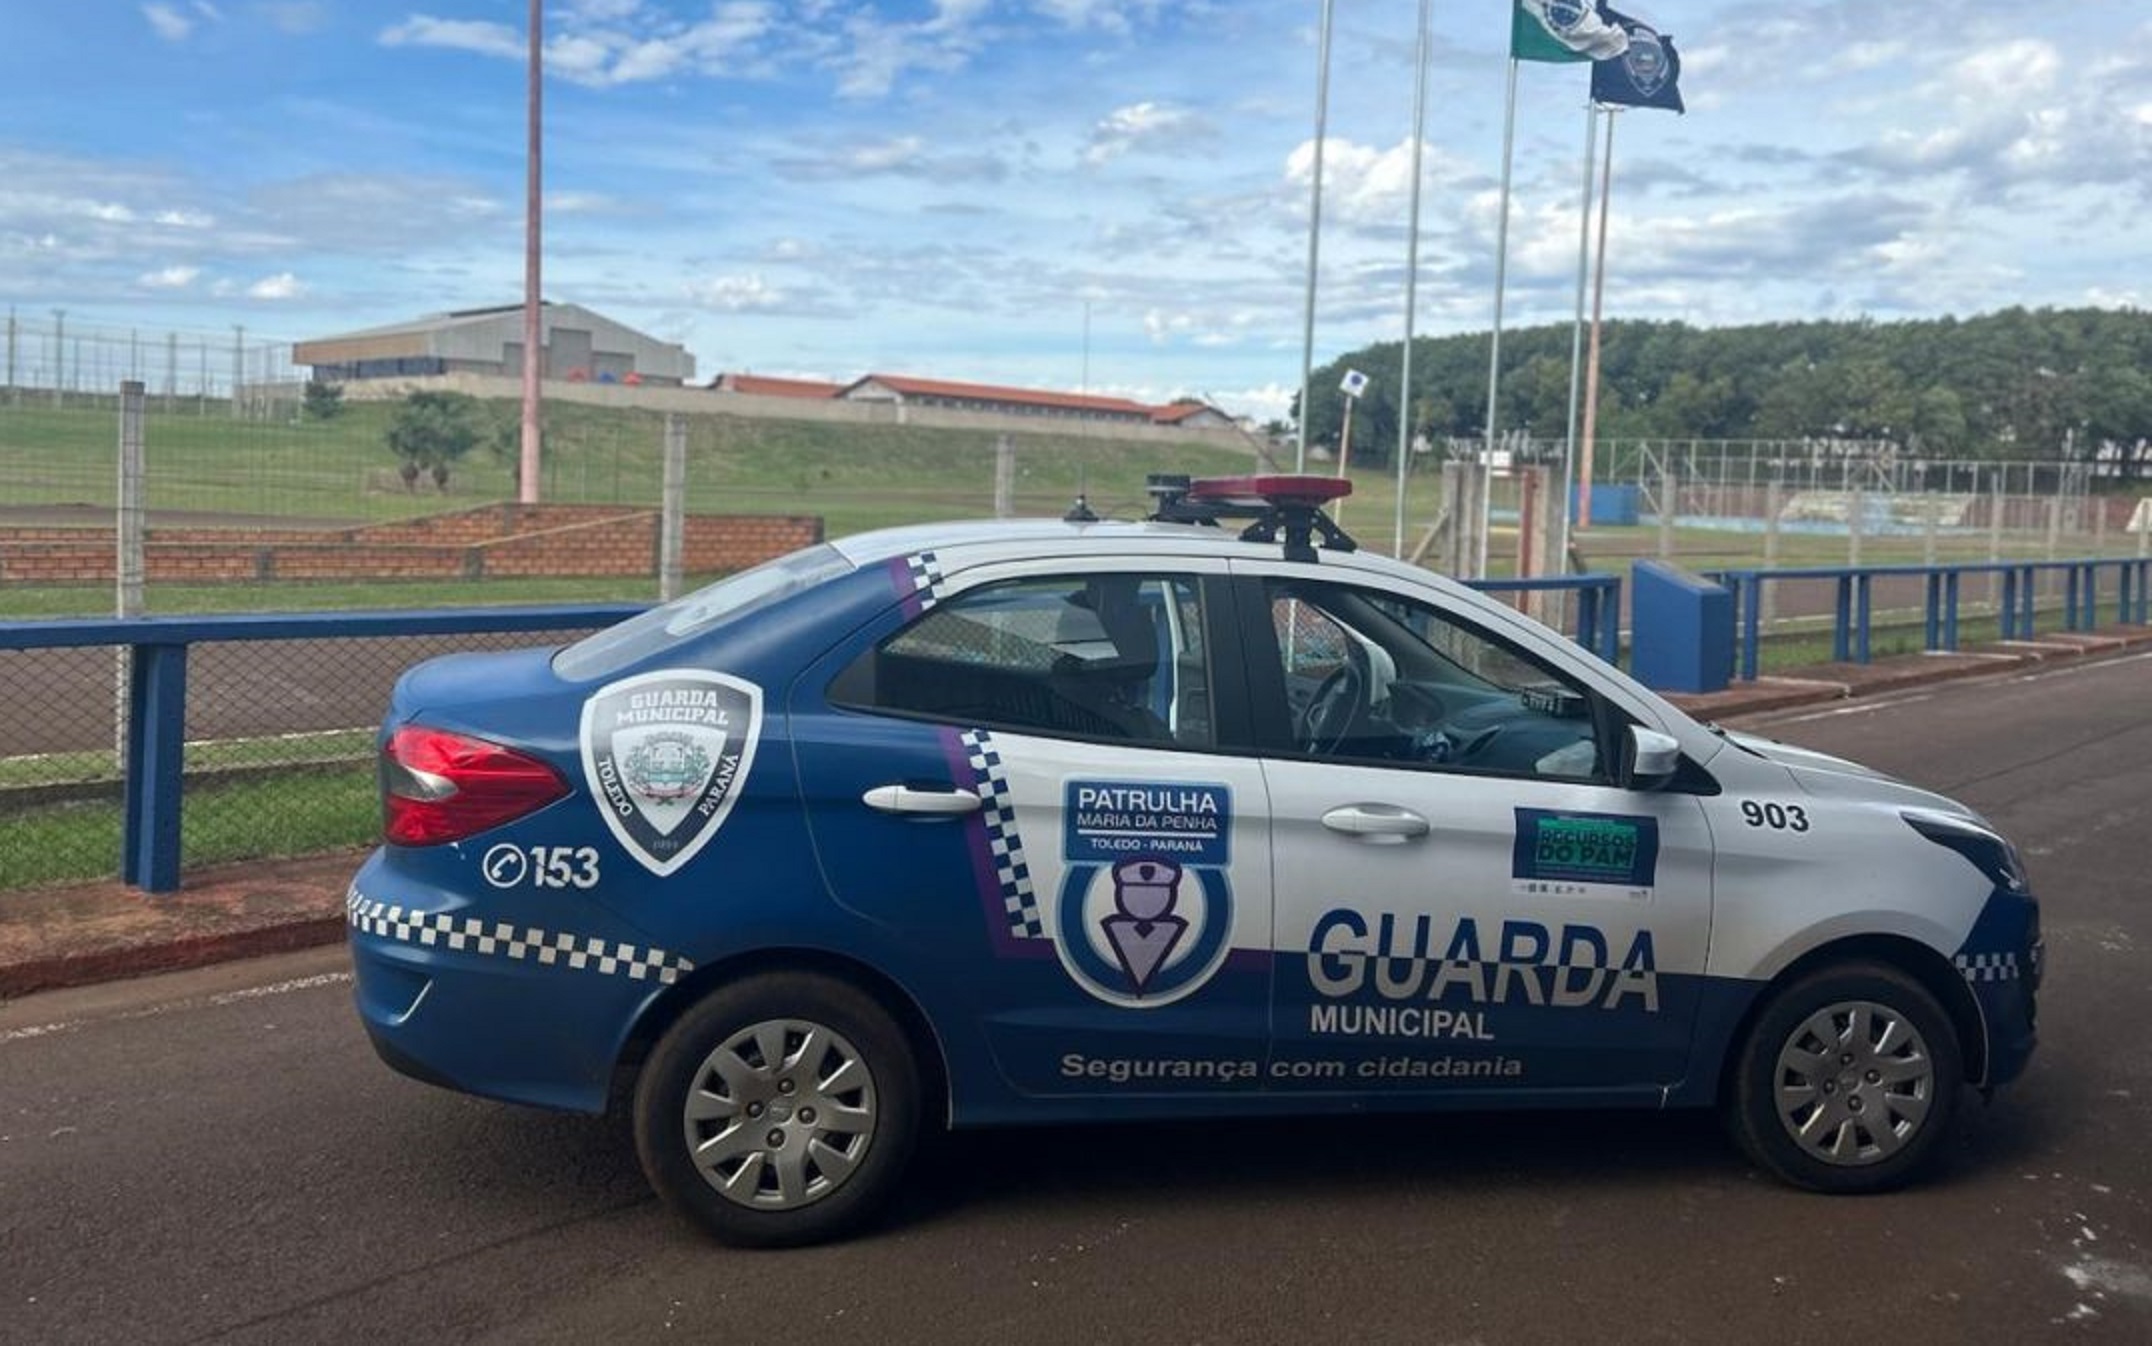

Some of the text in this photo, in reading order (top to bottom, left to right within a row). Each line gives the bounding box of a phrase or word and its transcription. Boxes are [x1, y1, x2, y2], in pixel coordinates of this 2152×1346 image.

[631, 689, 718, 709] GUARDA
[616, 707, 729, 725] MUNICIPAL
[599, 757, 633, 817] TOLEDO
[1078, 787, 1218, 814] PATRULHA
[1077, 812, 1217, 831] MARIA DA PENHA
[1741, 800, 1809, 832] 903
[1090, 838, 1141, 850] TOLEDO
[1538, 844, 1573, 862] DO
[530, 845, 600, 889] 153
[1307, 908, 1660, 1013] GUARDA
[1310, 1003, 1495, 1041] MUNICIPAL
[1061, 1053, 1522, 1083] Segurança com cidadania
